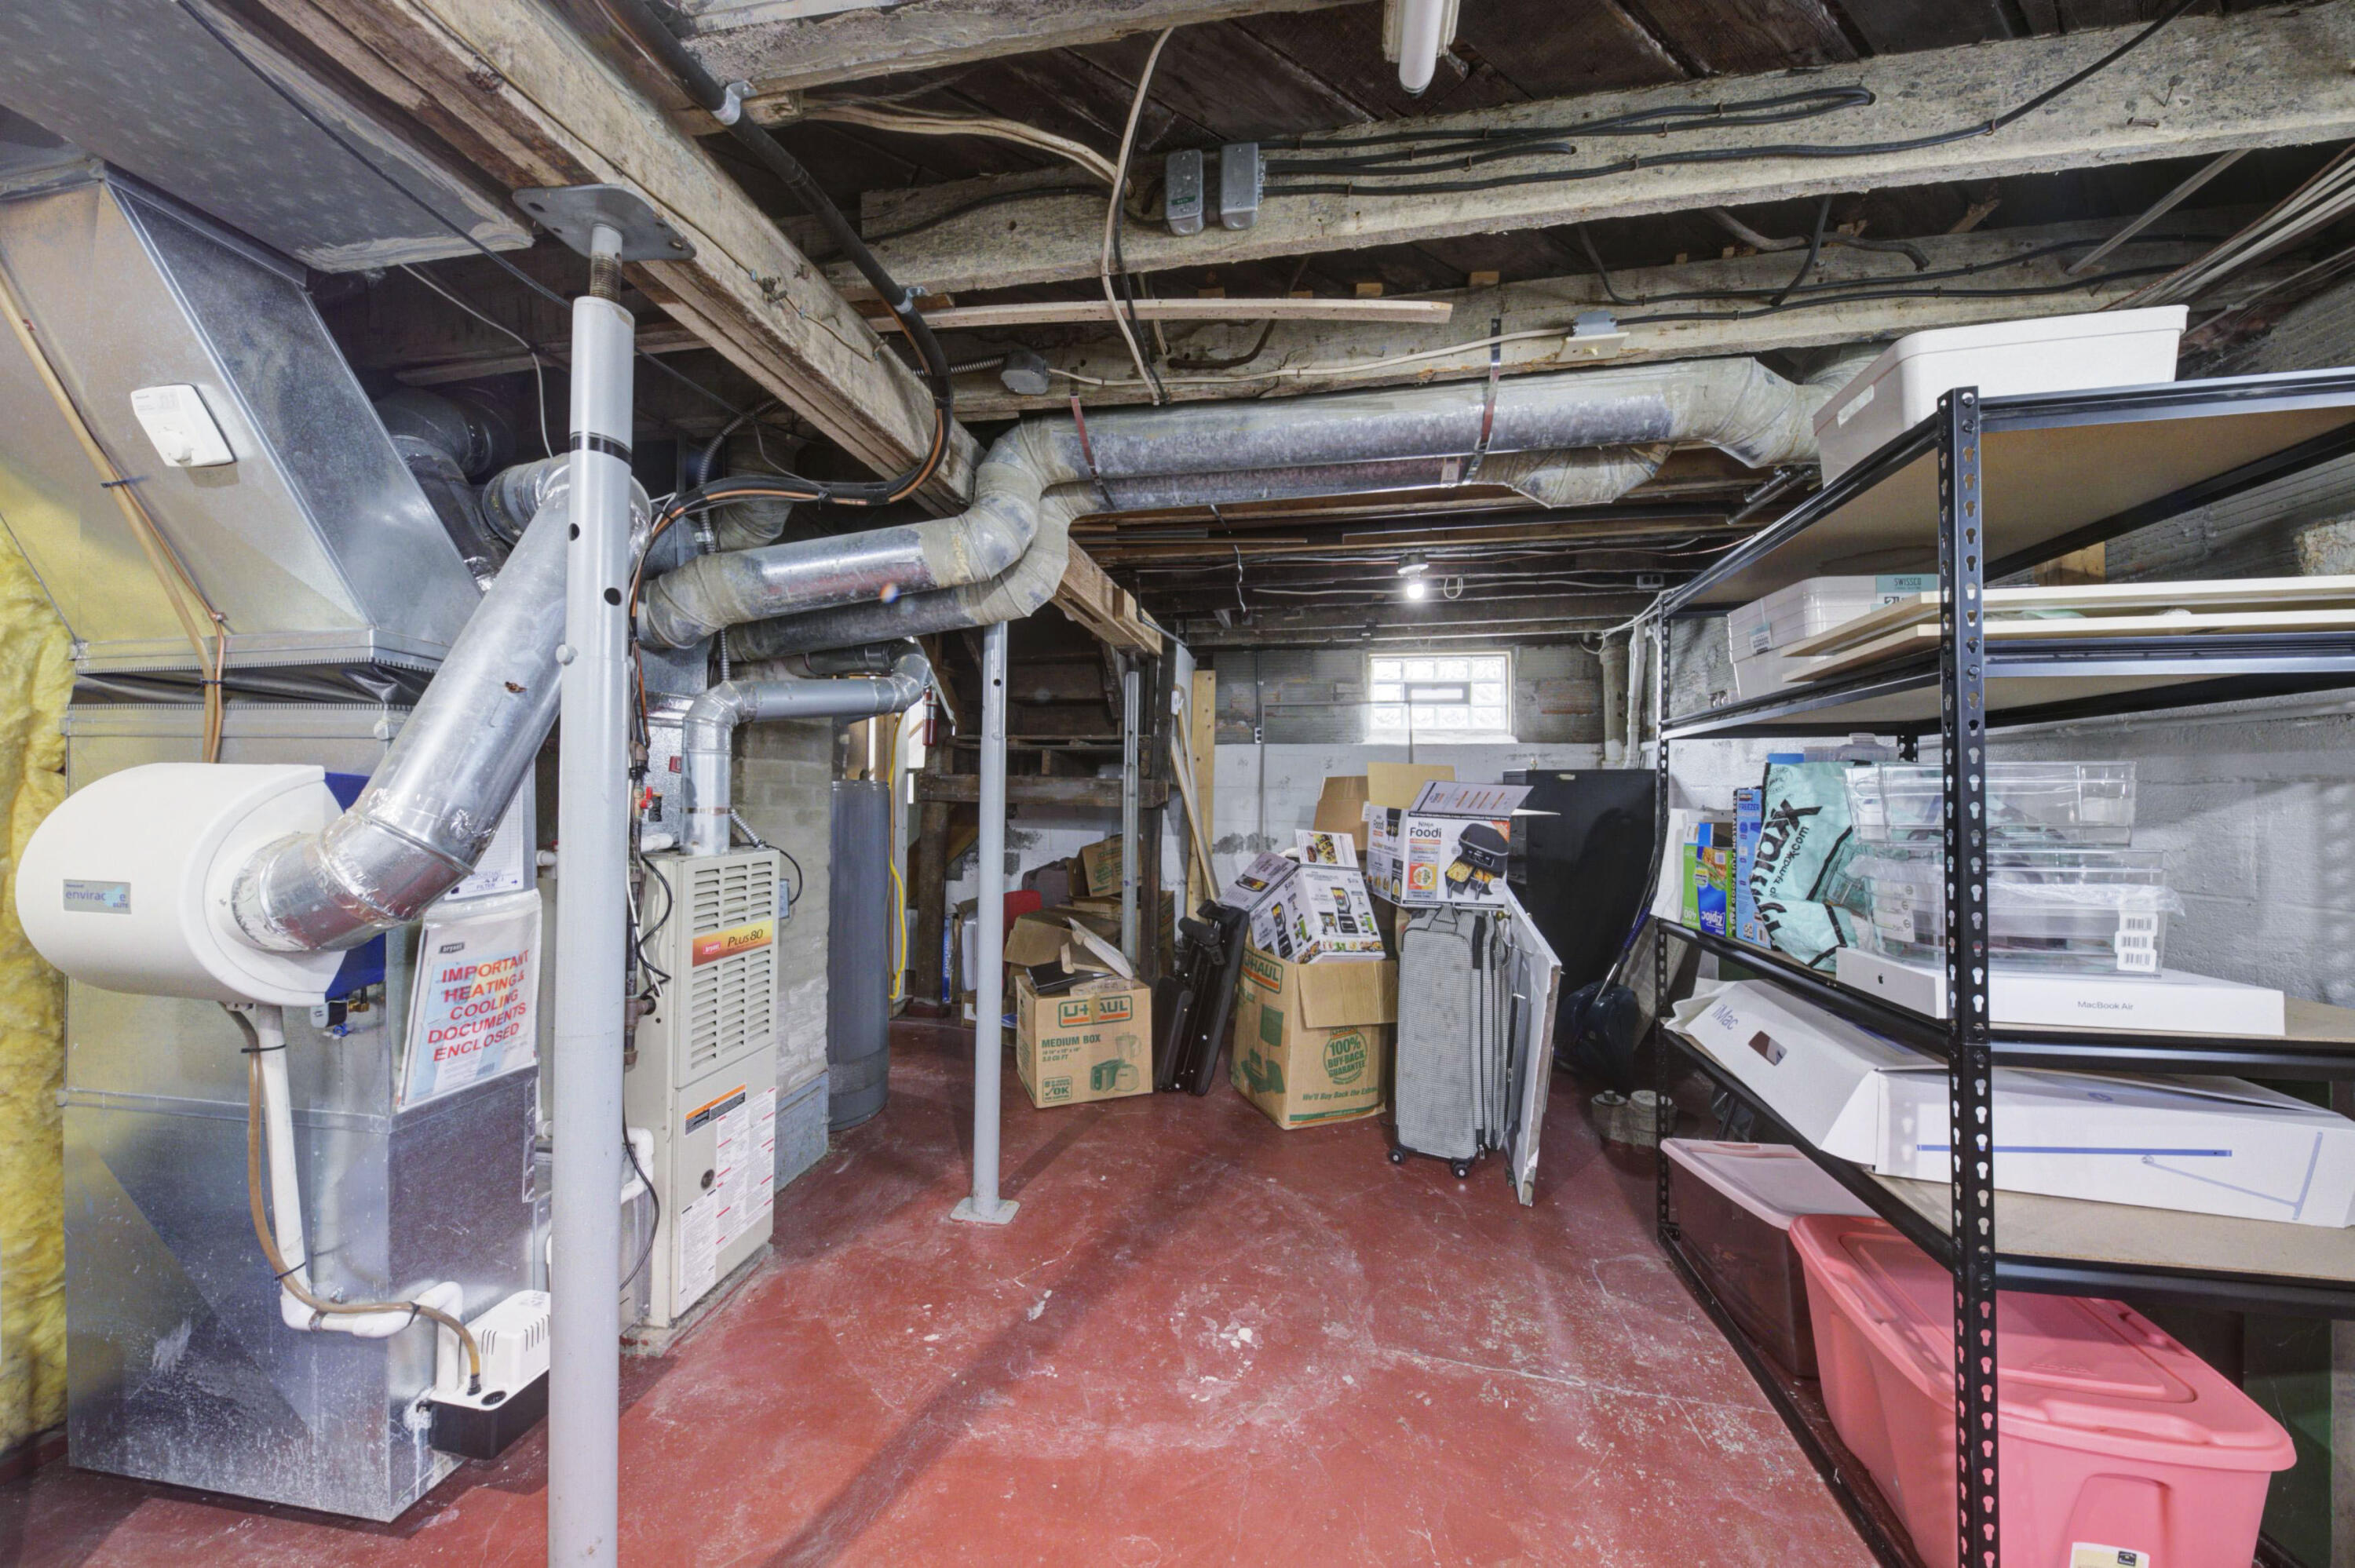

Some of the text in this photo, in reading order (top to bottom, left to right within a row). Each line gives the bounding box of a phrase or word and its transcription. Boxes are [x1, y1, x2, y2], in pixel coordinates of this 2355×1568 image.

[1410, 826, 1441, 838] Foodi
[1701, 910, 1723, 928] Ziploc
[750, 928, 764, 941] 80
[442, 943, 463, 953] bryant
[441, 950, 529, 983] IMPORTANT
[444, 970, 524, 1002] HEATING &
[450, 989, 518, 1020] COOLING
[2077, 1001, 2120, 1010] MacBook
[428, 1002, 526, 1044] DOCUMENTS
[1711, 1004, 1739, 1030] iMac
[433, 1023, 520, 1061] ENCLOSED
[1042, 1034, 1101, 1048] MEDIUM BOX
[1330, 1036, 1361, 1056] 100%
[1327, 1050, 1365, 1068] BUY-BACK
[1328, 1061, 1365, 1078] GUARANTEE
[1053, 1087, 1070, 1096] OK
[1334, 1090, 1349, 1099] Back
